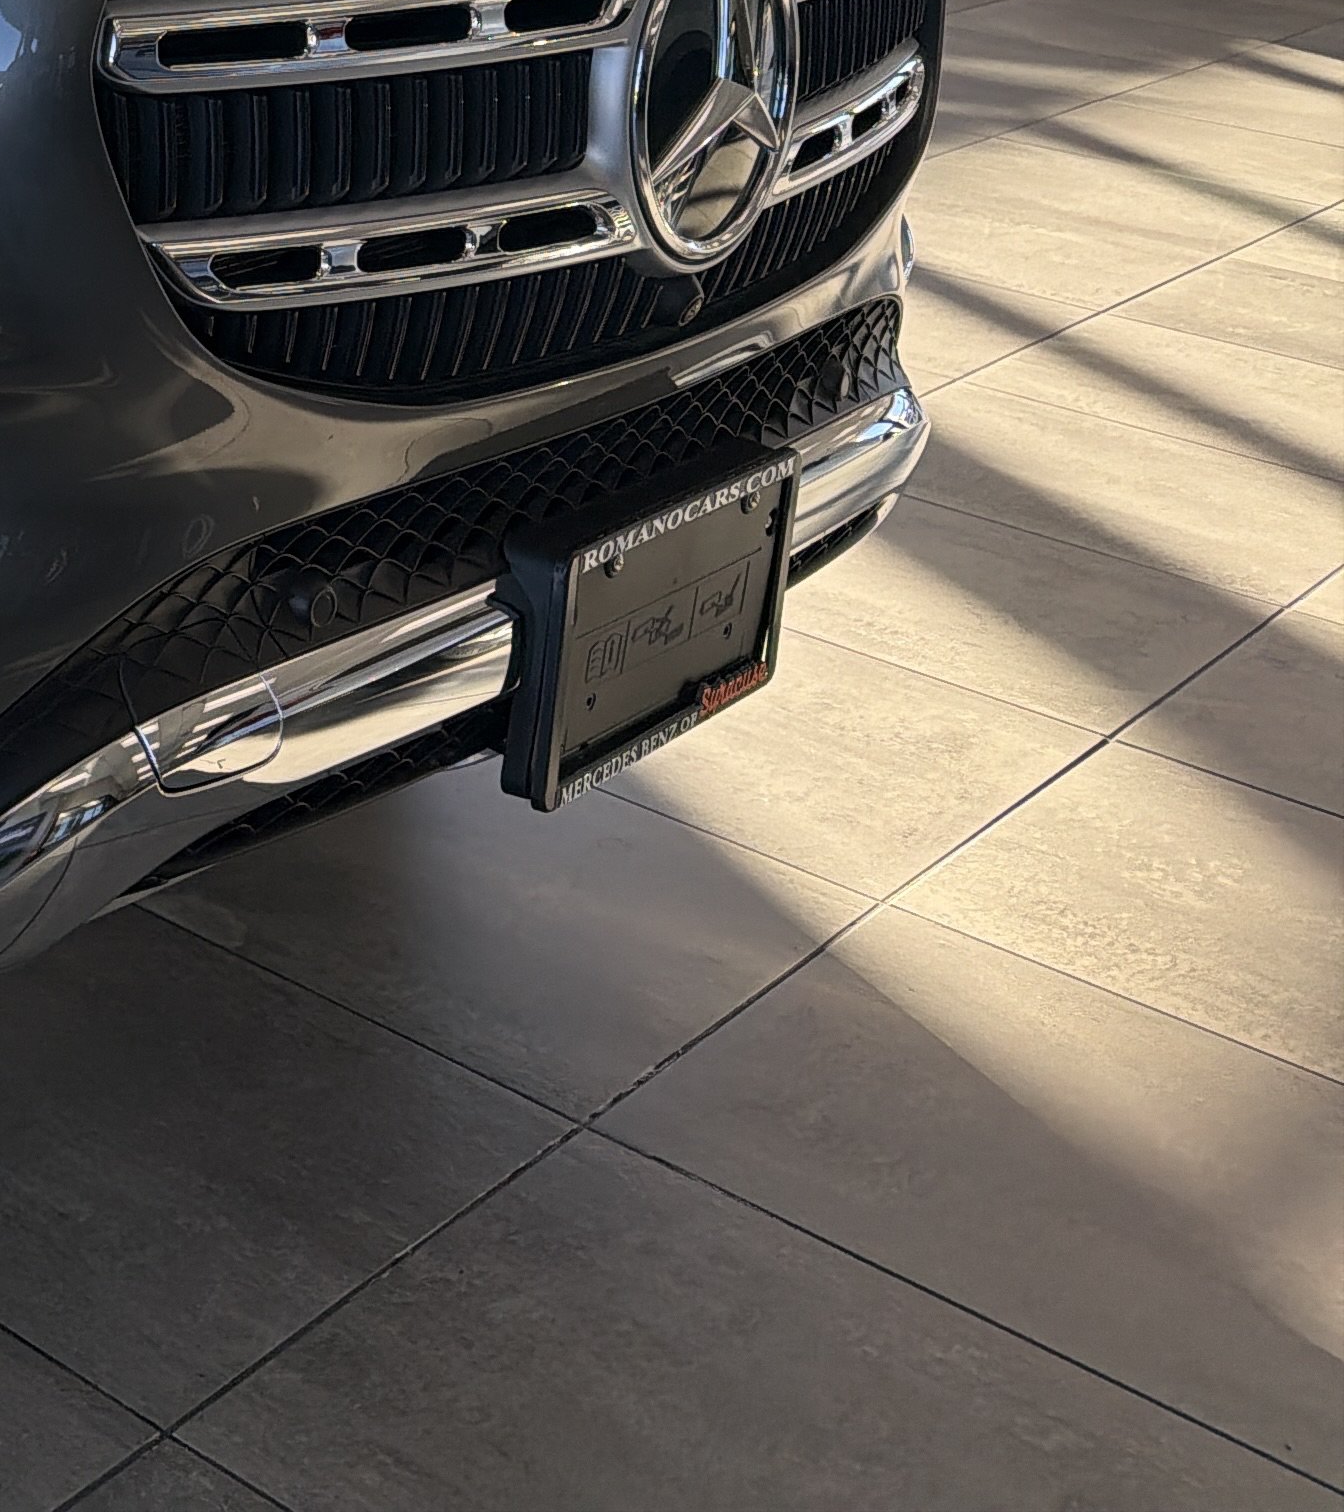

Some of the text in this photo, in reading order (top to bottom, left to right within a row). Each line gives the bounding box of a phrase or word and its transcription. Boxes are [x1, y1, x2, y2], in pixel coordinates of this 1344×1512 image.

[581, 456, 795, 573] ROMANOCARS.COM
[560, 662, 768, 806] MERCEDES BENZ OF Syracuse
